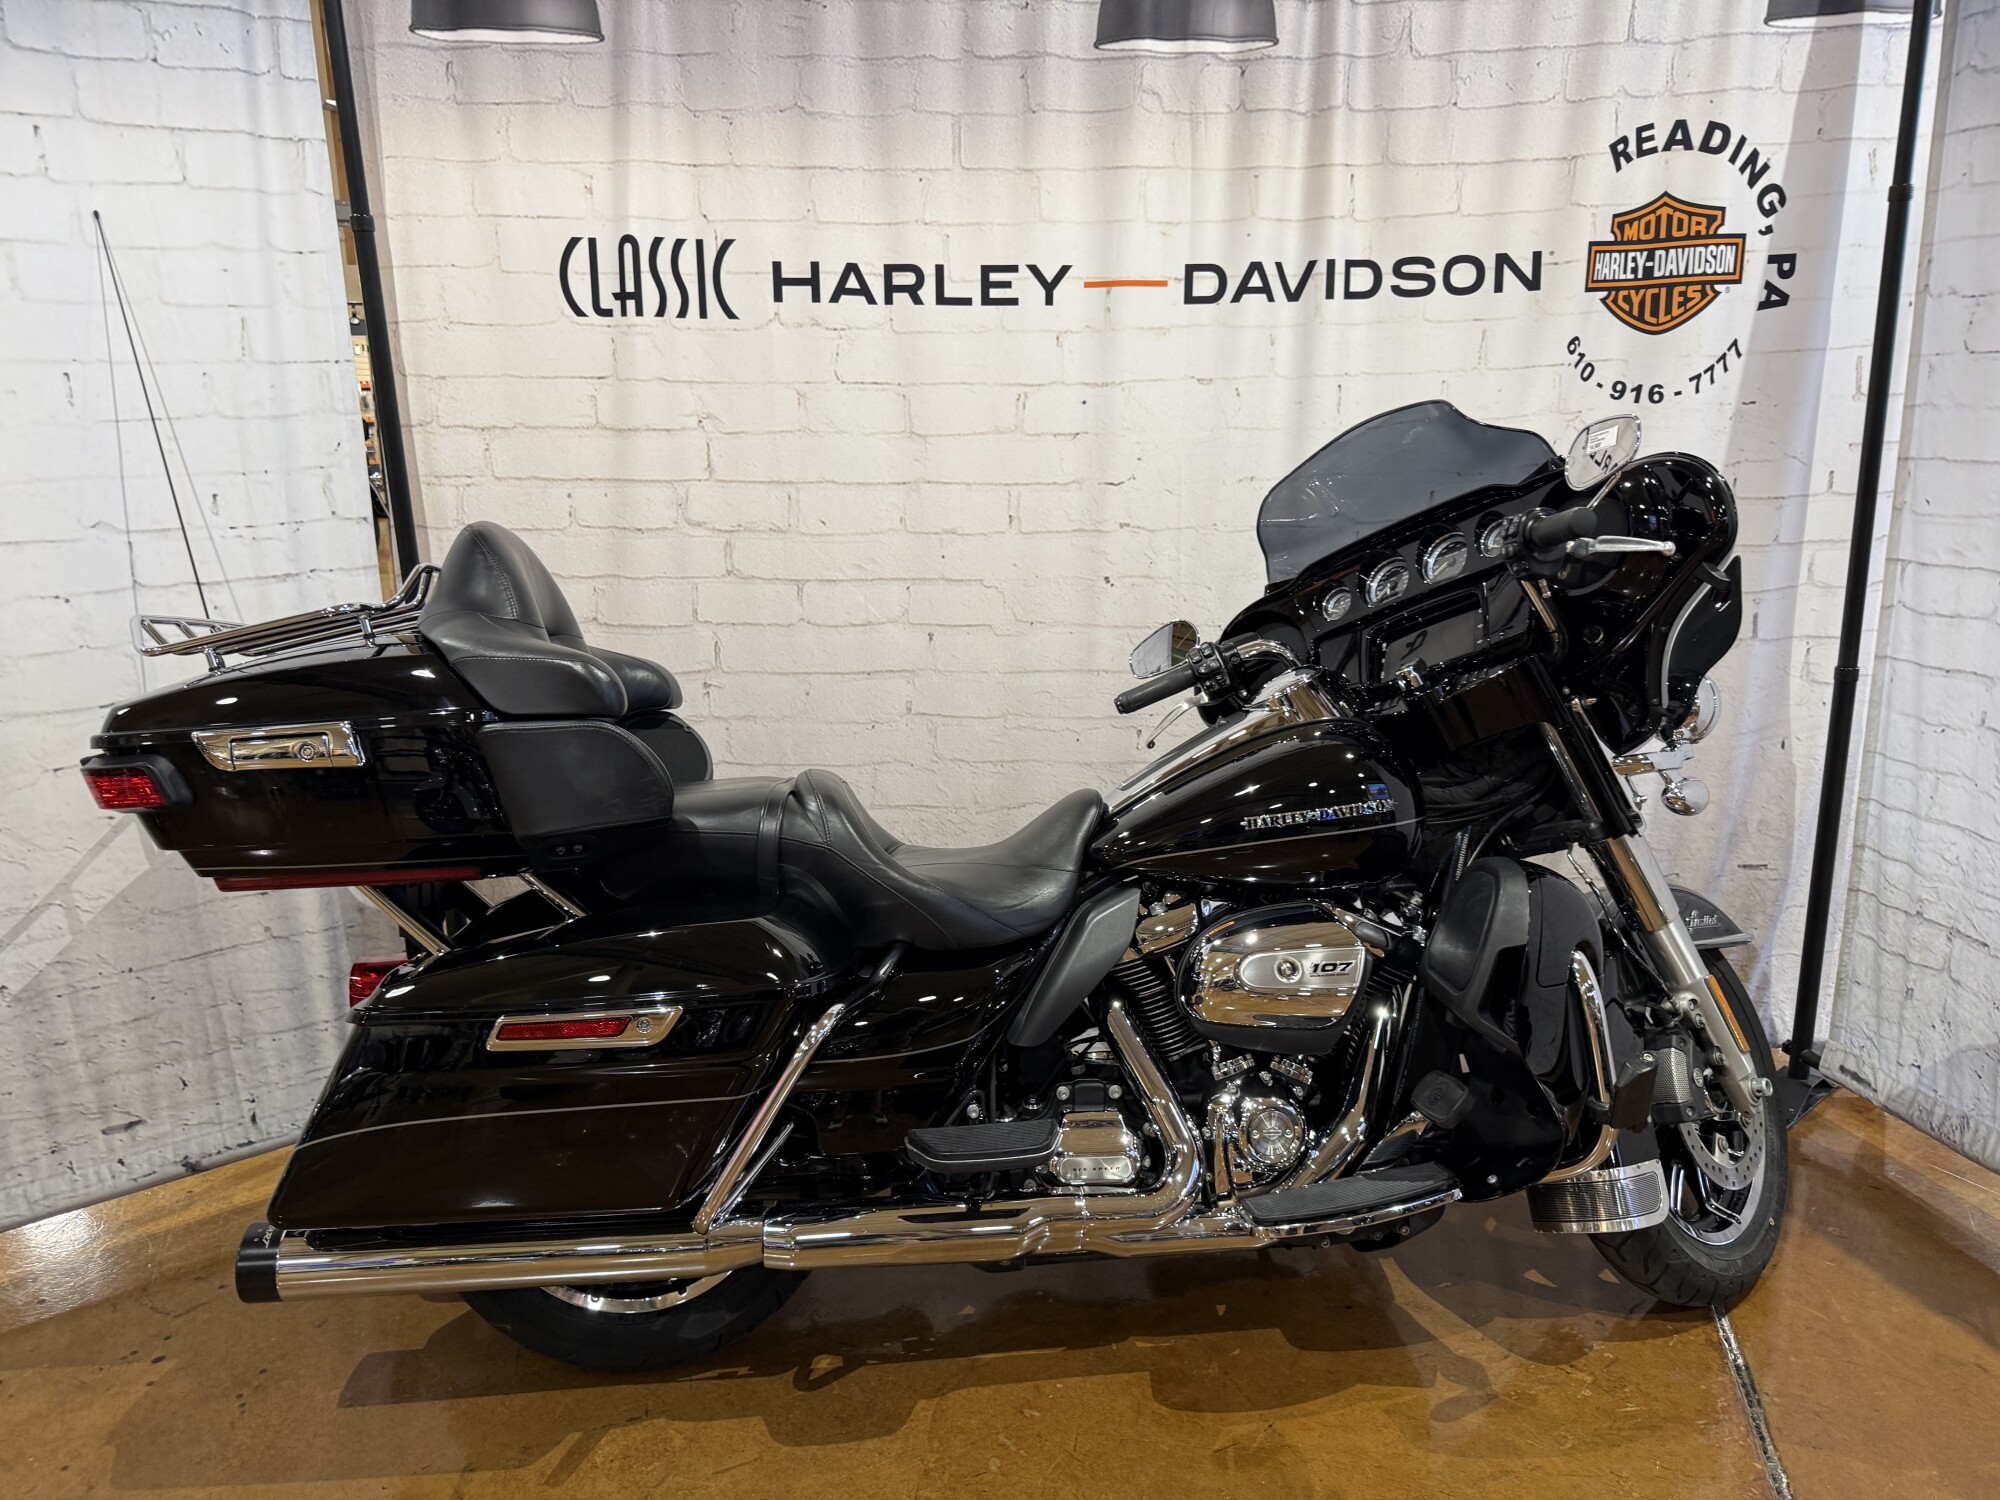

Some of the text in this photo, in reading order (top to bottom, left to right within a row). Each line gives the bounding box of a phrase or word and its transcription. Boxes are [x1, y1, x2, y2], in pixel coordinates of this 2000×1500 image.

[1608, 119, 1797, 312] READING, PA
[1623, 206, 1709, 242] MOTOR
[558, 233, 741, 320] CLASSIC
[1593, 244, 1737, 282] HARLEY-DAVIDSON
[1616, 284, 1703, 325] CYCLES
[1311, 961, 1355, 973] 107
